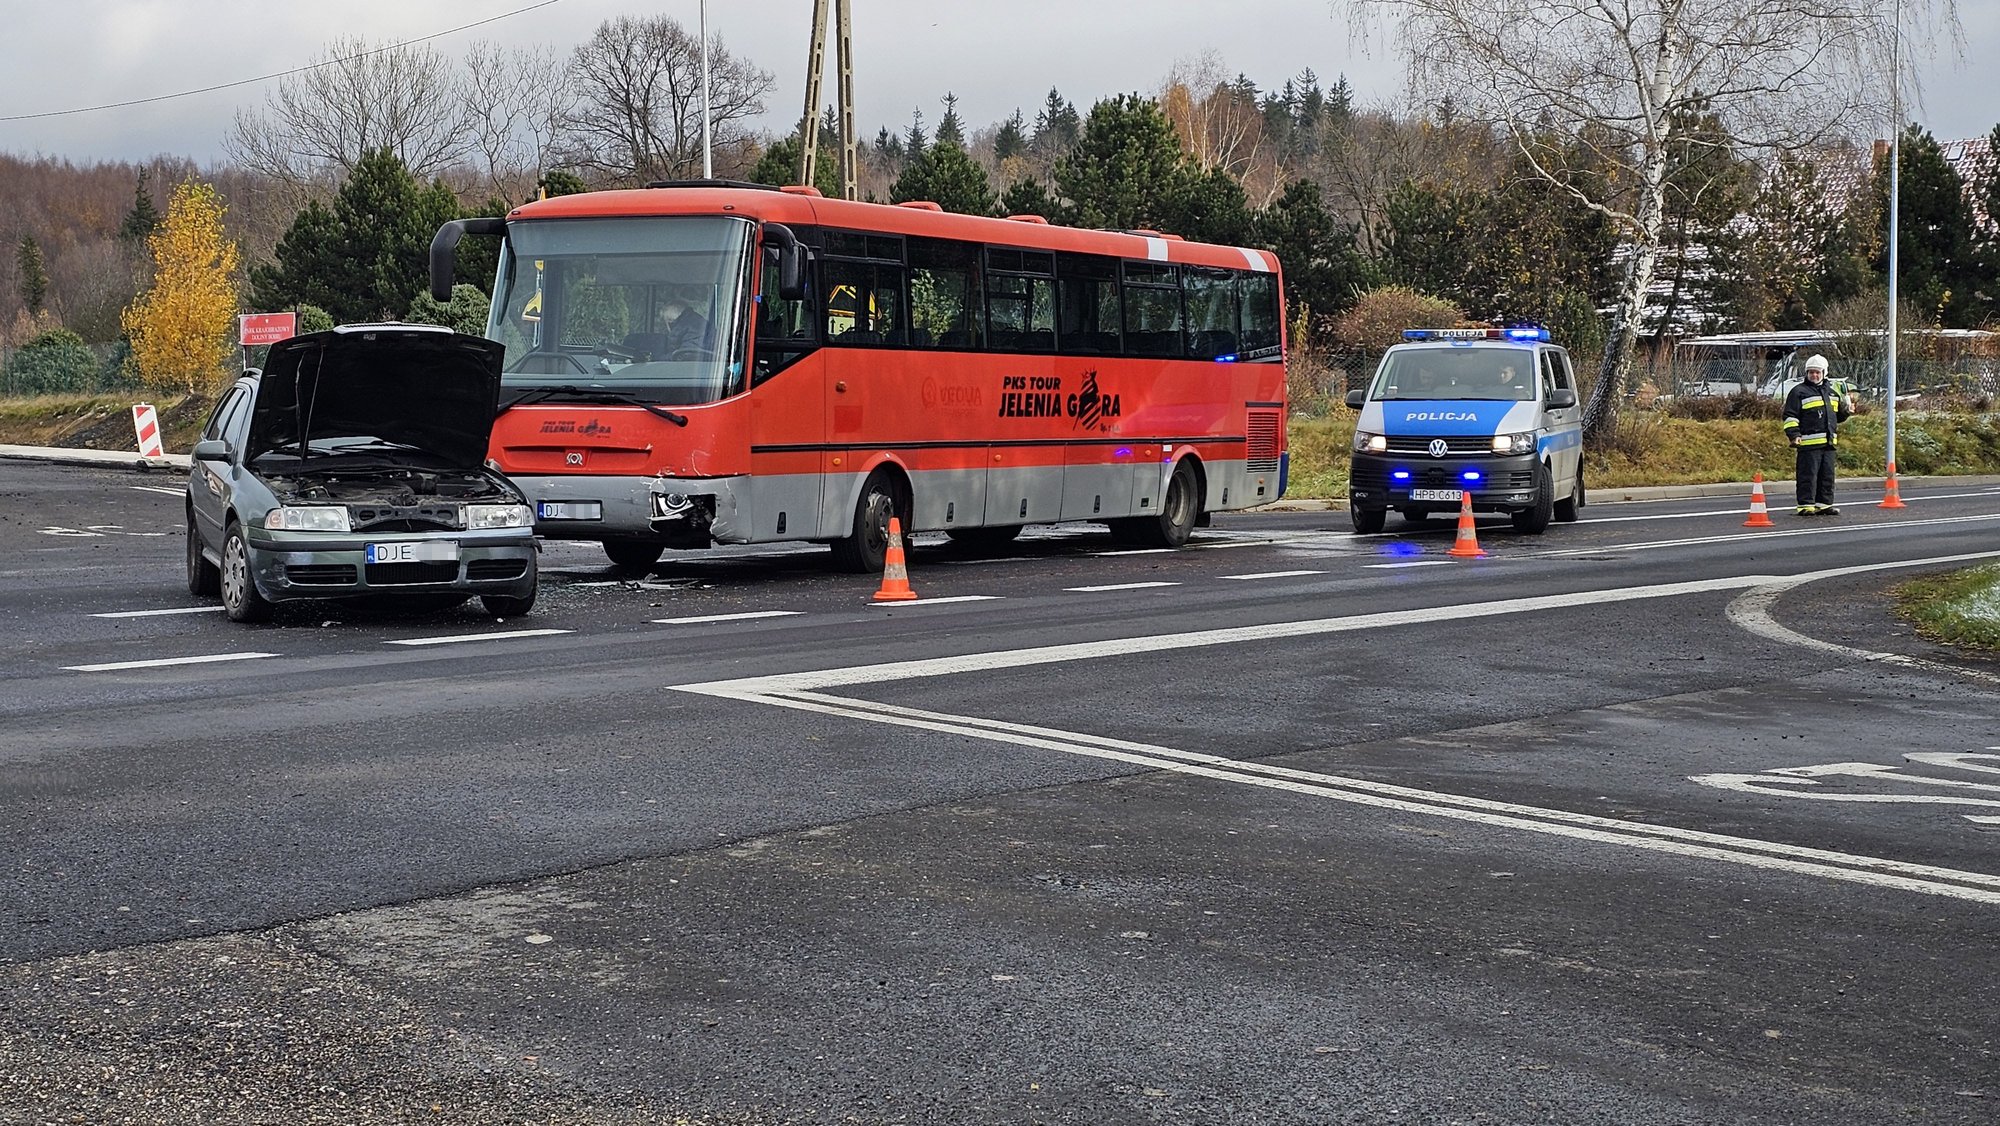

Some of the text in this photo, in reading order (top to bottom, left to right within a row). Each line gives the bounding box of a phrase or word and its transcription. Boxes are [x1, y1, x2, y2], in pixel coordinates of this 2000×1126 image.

[1003, 376, 1062, 390] PKS TOUR
[998, 393, 1062, 418] JELENIA
[1405, 411, 1478, 422] POLICJA
[539, 425, 575, 434] JELENIA
[1415, 490, 1462, 501] HPB C613
[545, 504, 559, 517] DJ
[377, 544, 411, 561] DJE
